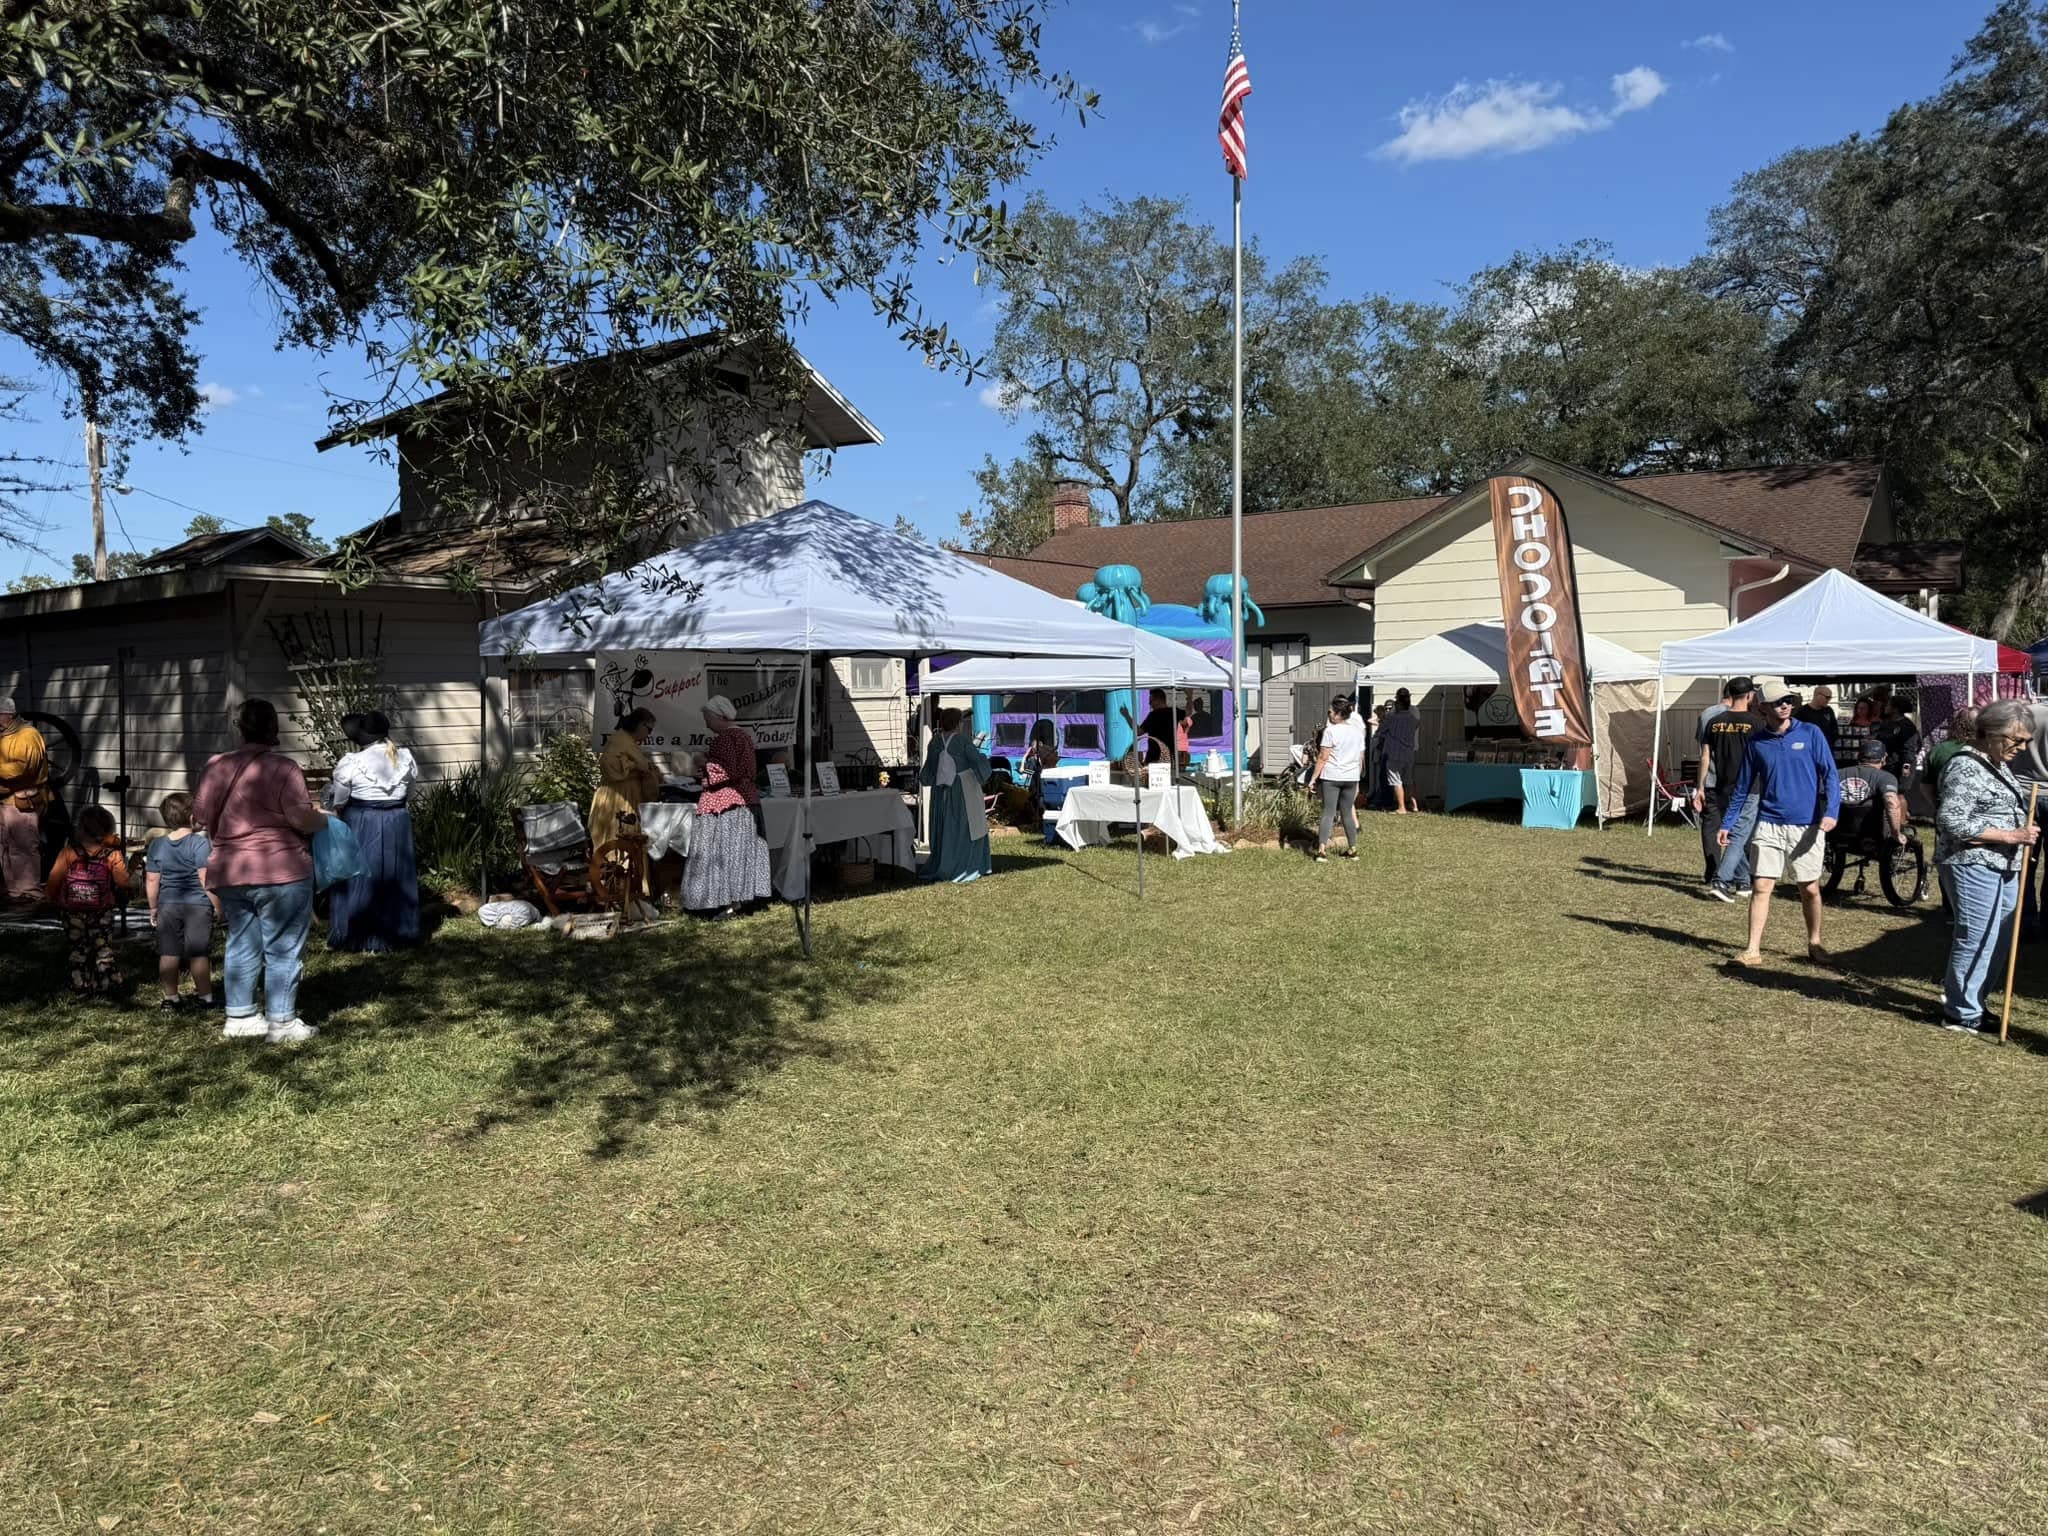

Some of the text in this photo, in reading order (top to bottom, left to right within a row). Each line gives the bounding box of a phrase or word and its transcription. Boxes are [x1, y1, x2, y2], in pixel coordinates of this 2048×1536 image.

[654, 671, 702, 699] Support
[711, 673, 729, 686] The
[1711, 722, 1752, 734] STAFF
[671, 735, 681, 746] a
[756, 728, 794, 744] Today!
